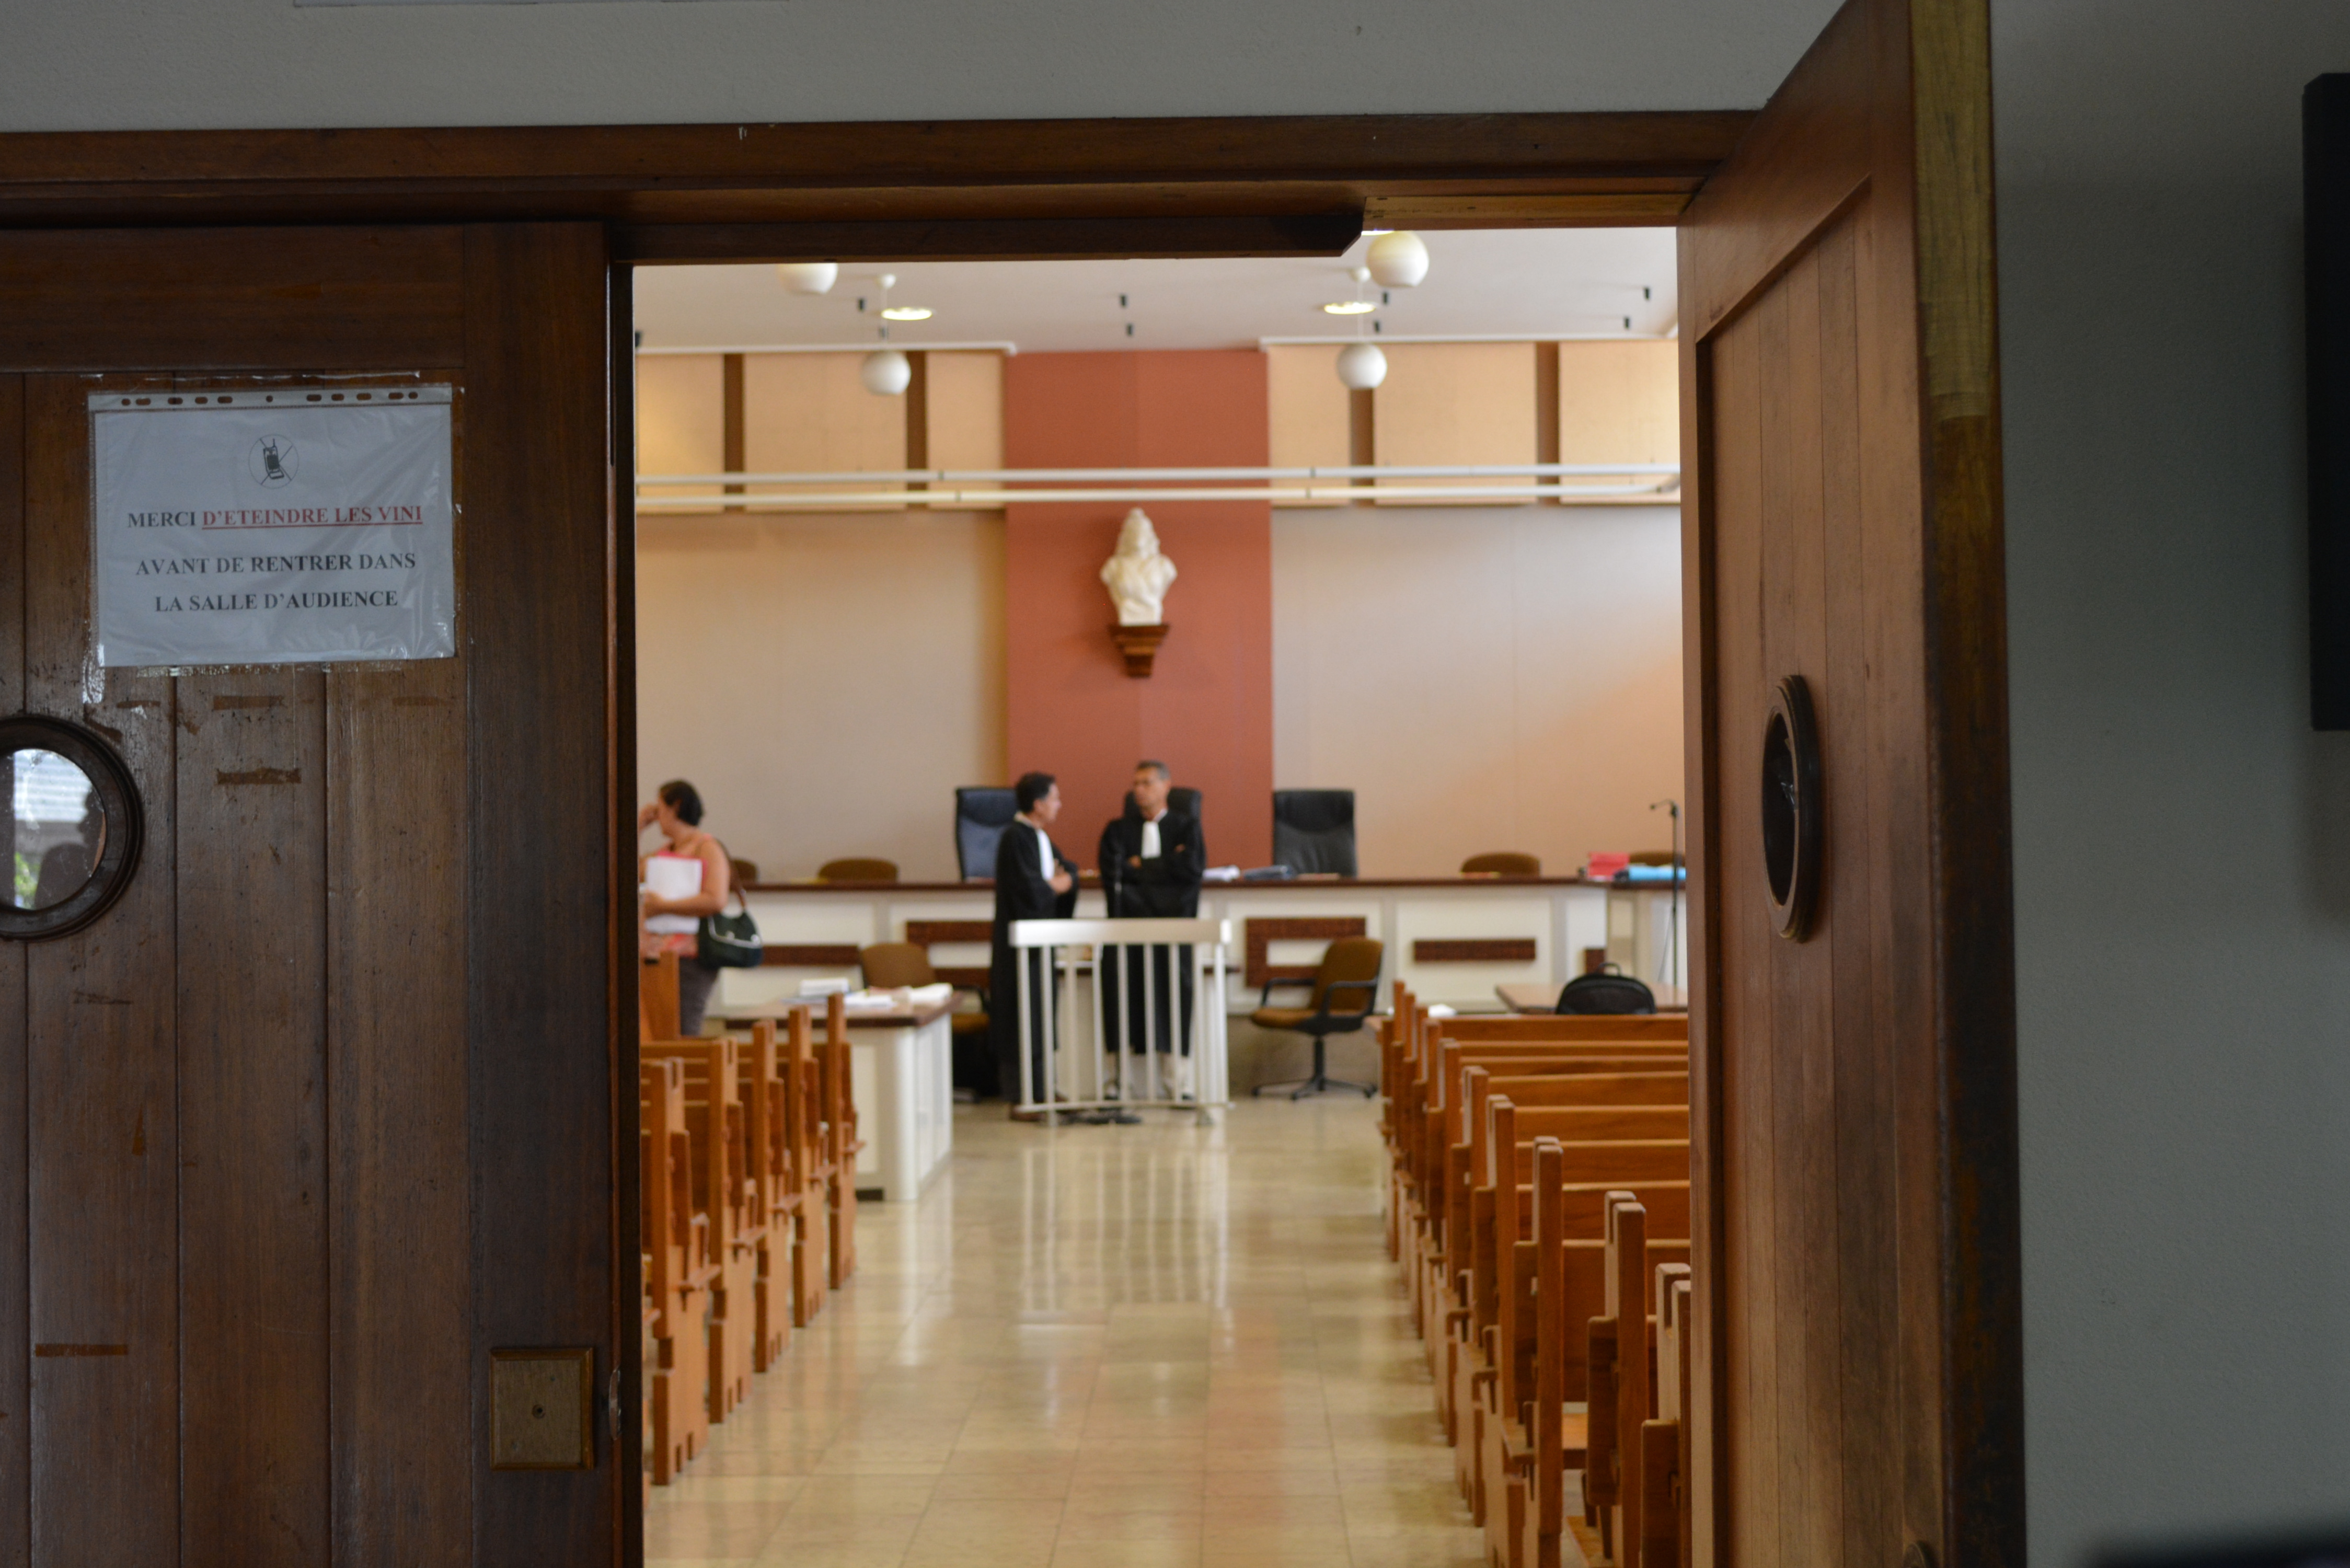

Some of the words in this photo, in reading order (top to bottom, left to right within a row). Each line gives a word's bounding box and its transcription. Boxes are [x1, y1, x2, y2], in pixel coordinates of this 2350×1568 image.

[128, 511, 196, 528] MERCI
[203, 508, 329, 526] D'ETEINDRE
[335, 506, 372, 523] LES
[378, 505, 421, 521] VINI
[136, 558, 209, 575] AVANT
[216, 557, 244, 573] DE
[251, 555, 352, 573] RENTRER
[359, 553, 416, 569] DANS
[156, 596, 183, 612] LA
[189, 594, 258, 611] SALLE
[264, 591, 398, 609] D'AUDIENCE
